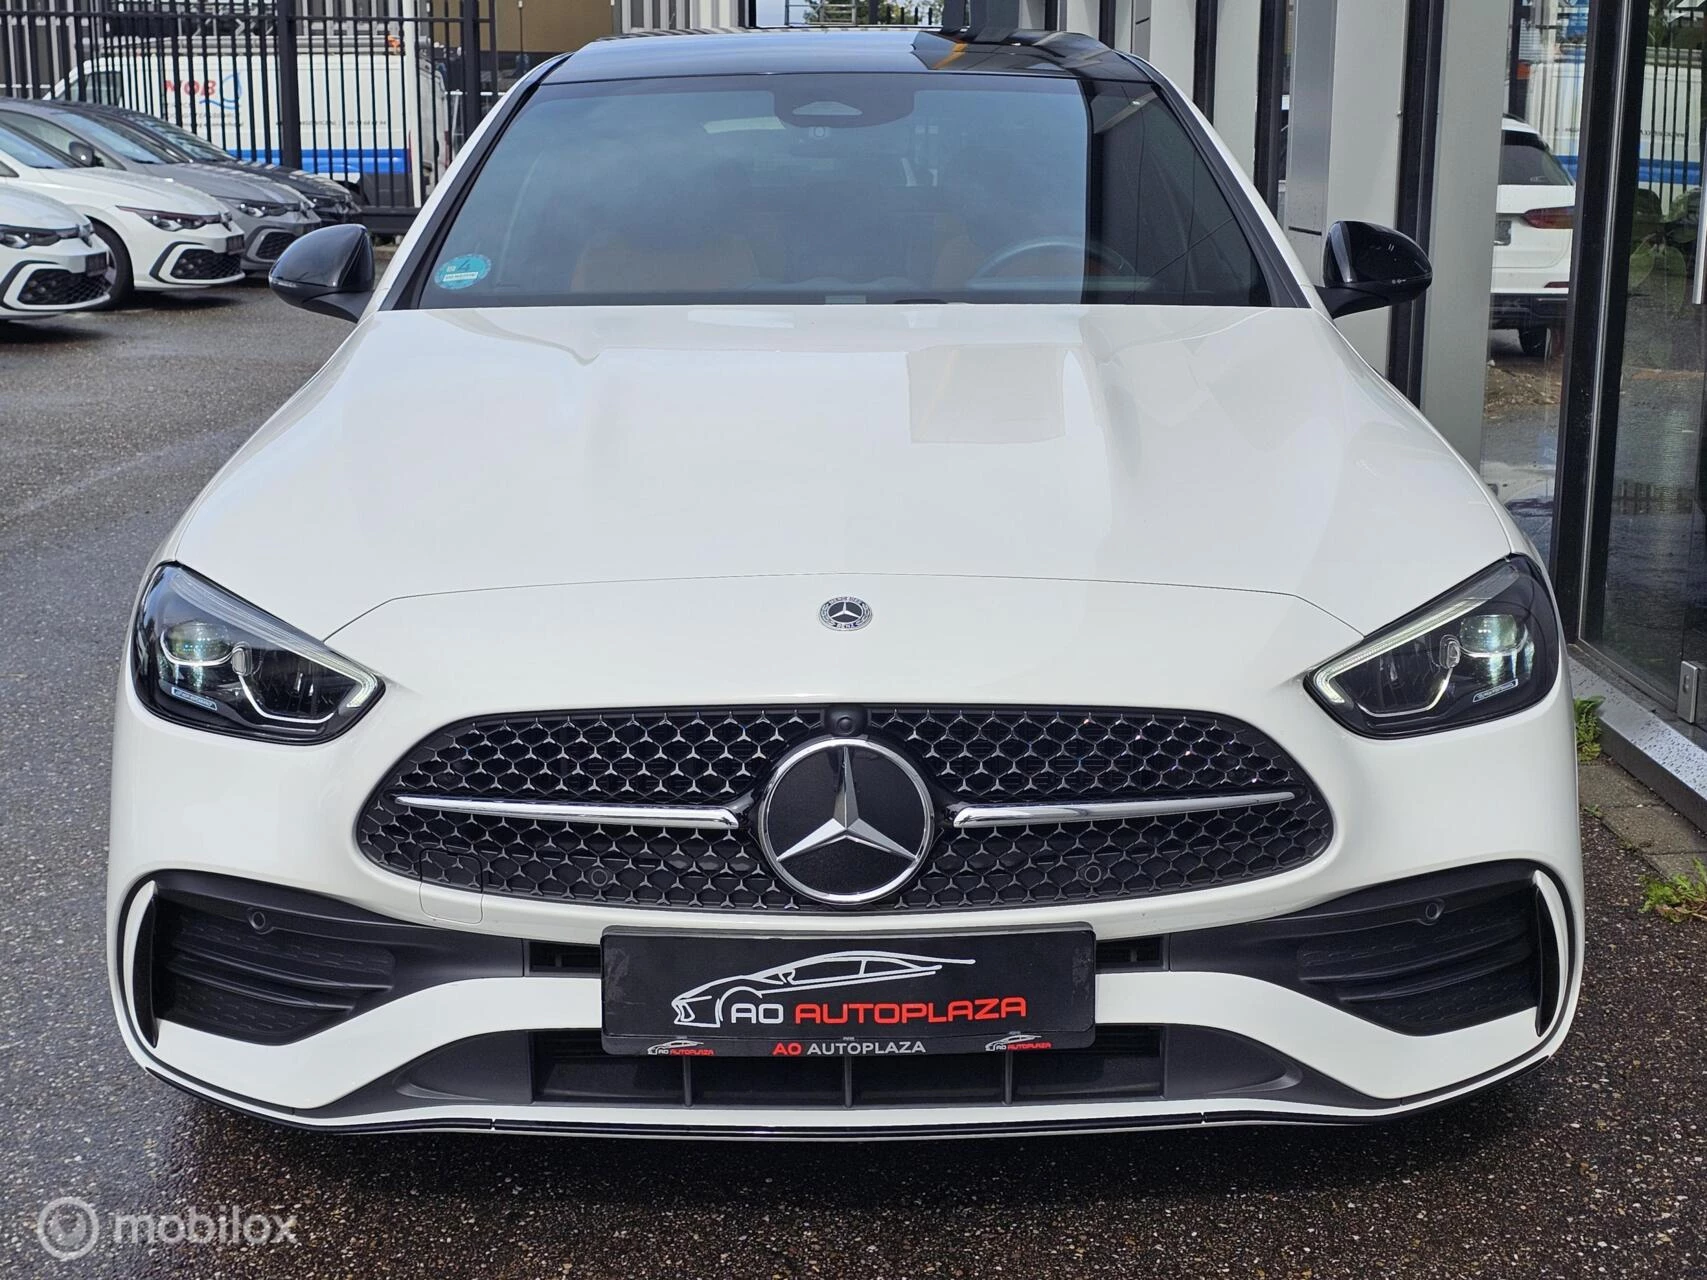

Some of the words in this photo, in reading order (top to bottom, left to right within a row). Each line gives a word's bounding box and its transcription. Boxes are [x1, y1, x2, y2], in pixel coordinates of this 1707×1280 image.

[731, 1003, 784, 1024] AO
[795, 997, 1027, 1024] AUTOPLAZA
[670, 1048, 715, 1056] AUTOPLAZA
[772, 1042, 803, 1056] AO
[807, 1041, 927, 1055] AUTOPLAZA
